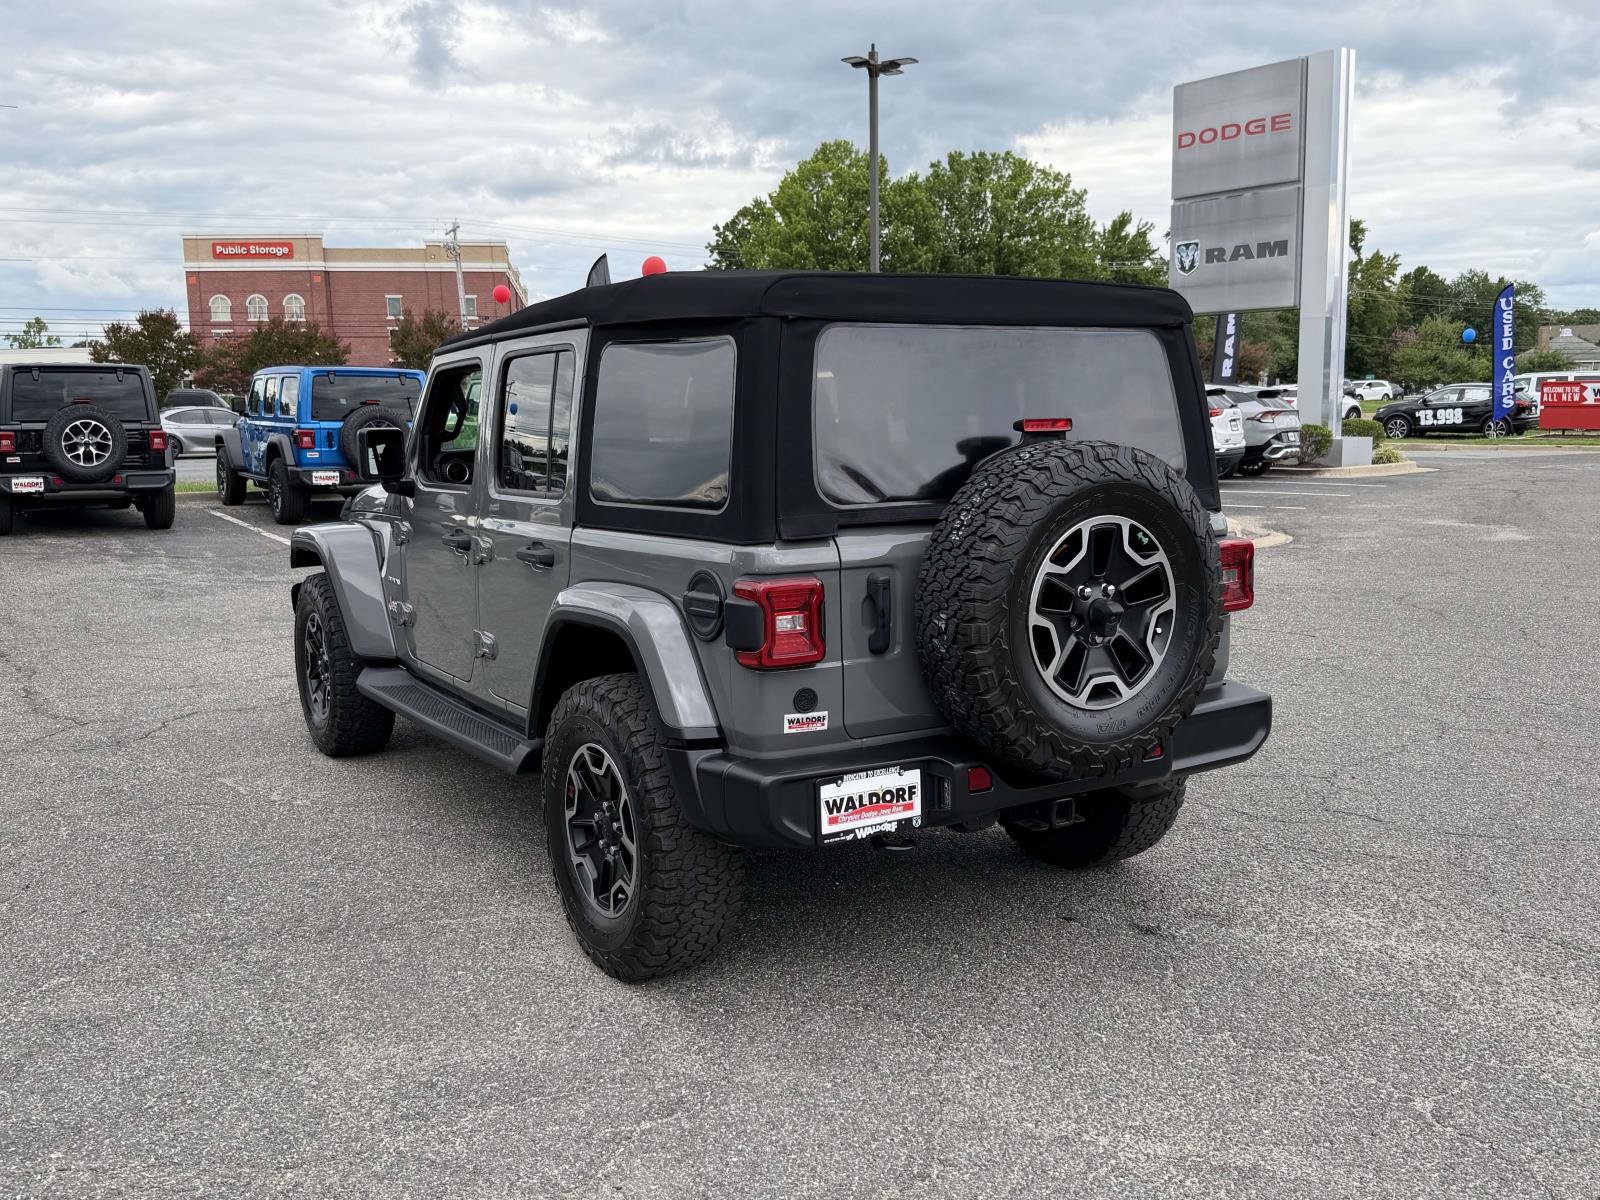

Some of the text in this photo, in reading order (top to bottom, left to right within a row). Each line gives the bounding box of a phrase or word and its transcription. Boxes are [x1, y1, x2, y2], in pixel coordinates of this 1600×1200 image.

[1177, 113, 1291, 149] DODGE
[216, 245, 247, 255] Public
[1205, 240, 1288, 264] RAM
[1221, 313, 1236, 377] RAM
[1500, 297, 1515, 409] USED CARS
[1543, 392, 1580, 402] ALL NEW
[787, 715, 826, 725] WALDORF
[867, 769, 875, 779] TO
[823, 785, 917, 815] WALDORF
[855, 821, 898, 839] WALDORF
